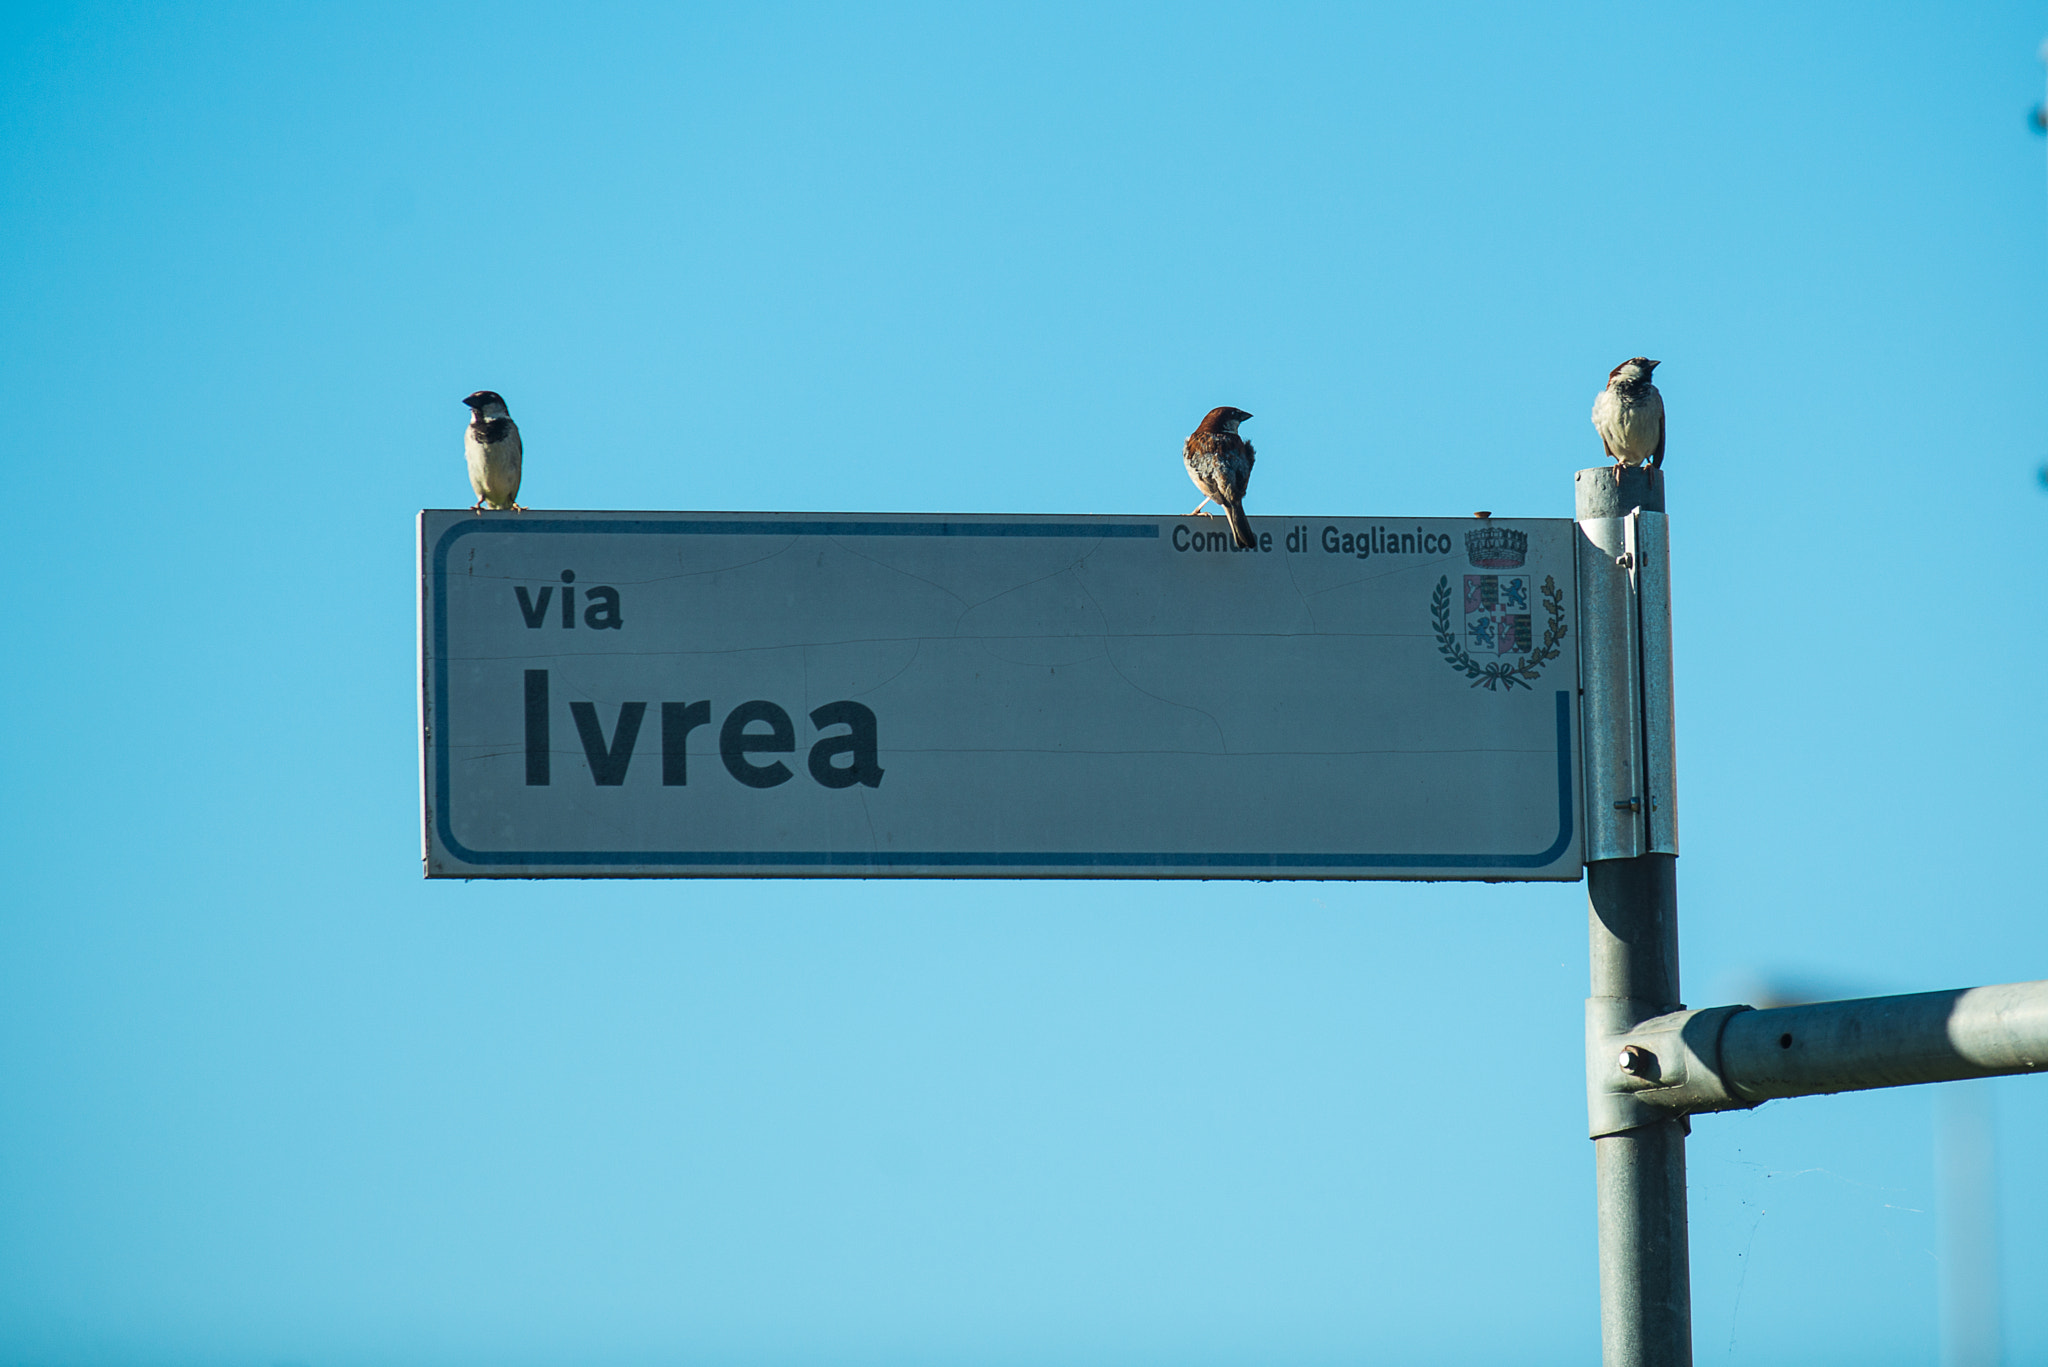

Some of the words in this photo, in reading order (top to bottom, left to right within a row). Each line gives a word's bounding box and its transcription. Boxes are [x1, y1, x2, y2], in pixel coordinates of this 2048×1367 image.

[1286, 525, 1308, 553] di
[1321, 525, 1452, 560] Gaglianico
[513, 569, 625, 631] via
[524, 668, 886, 790] Ivrea
